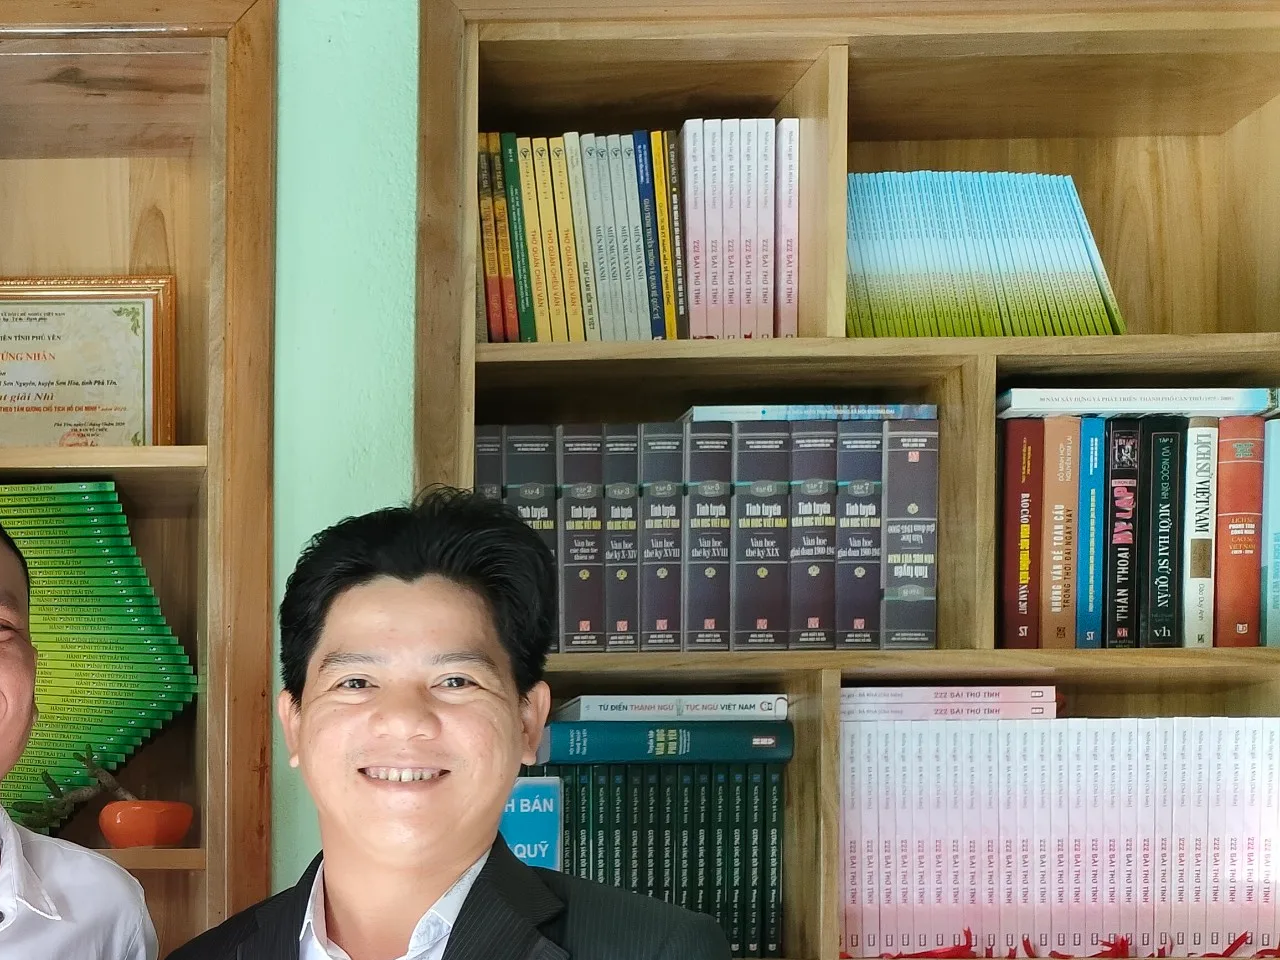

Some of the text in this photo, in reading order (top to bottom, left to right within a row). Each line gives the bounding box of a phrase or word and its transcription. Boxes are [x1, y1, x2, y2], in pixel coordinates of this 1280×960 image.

[25, 352, 56, 361] NHẬN
[1194, 434, 1212, 461] LỊCH
[1193, 480, 1210, 505] VIỆT
[1157, 504, 1172, 533] MƯỜI
[1195, 506, 1209, 533] NAM
[1157, 535, 1169, 556] HAI
[1157, 558, 1170, 573] SỨ
[739, 703, 756, 711] NAM
[520, 795, 554, 812] BÁN
